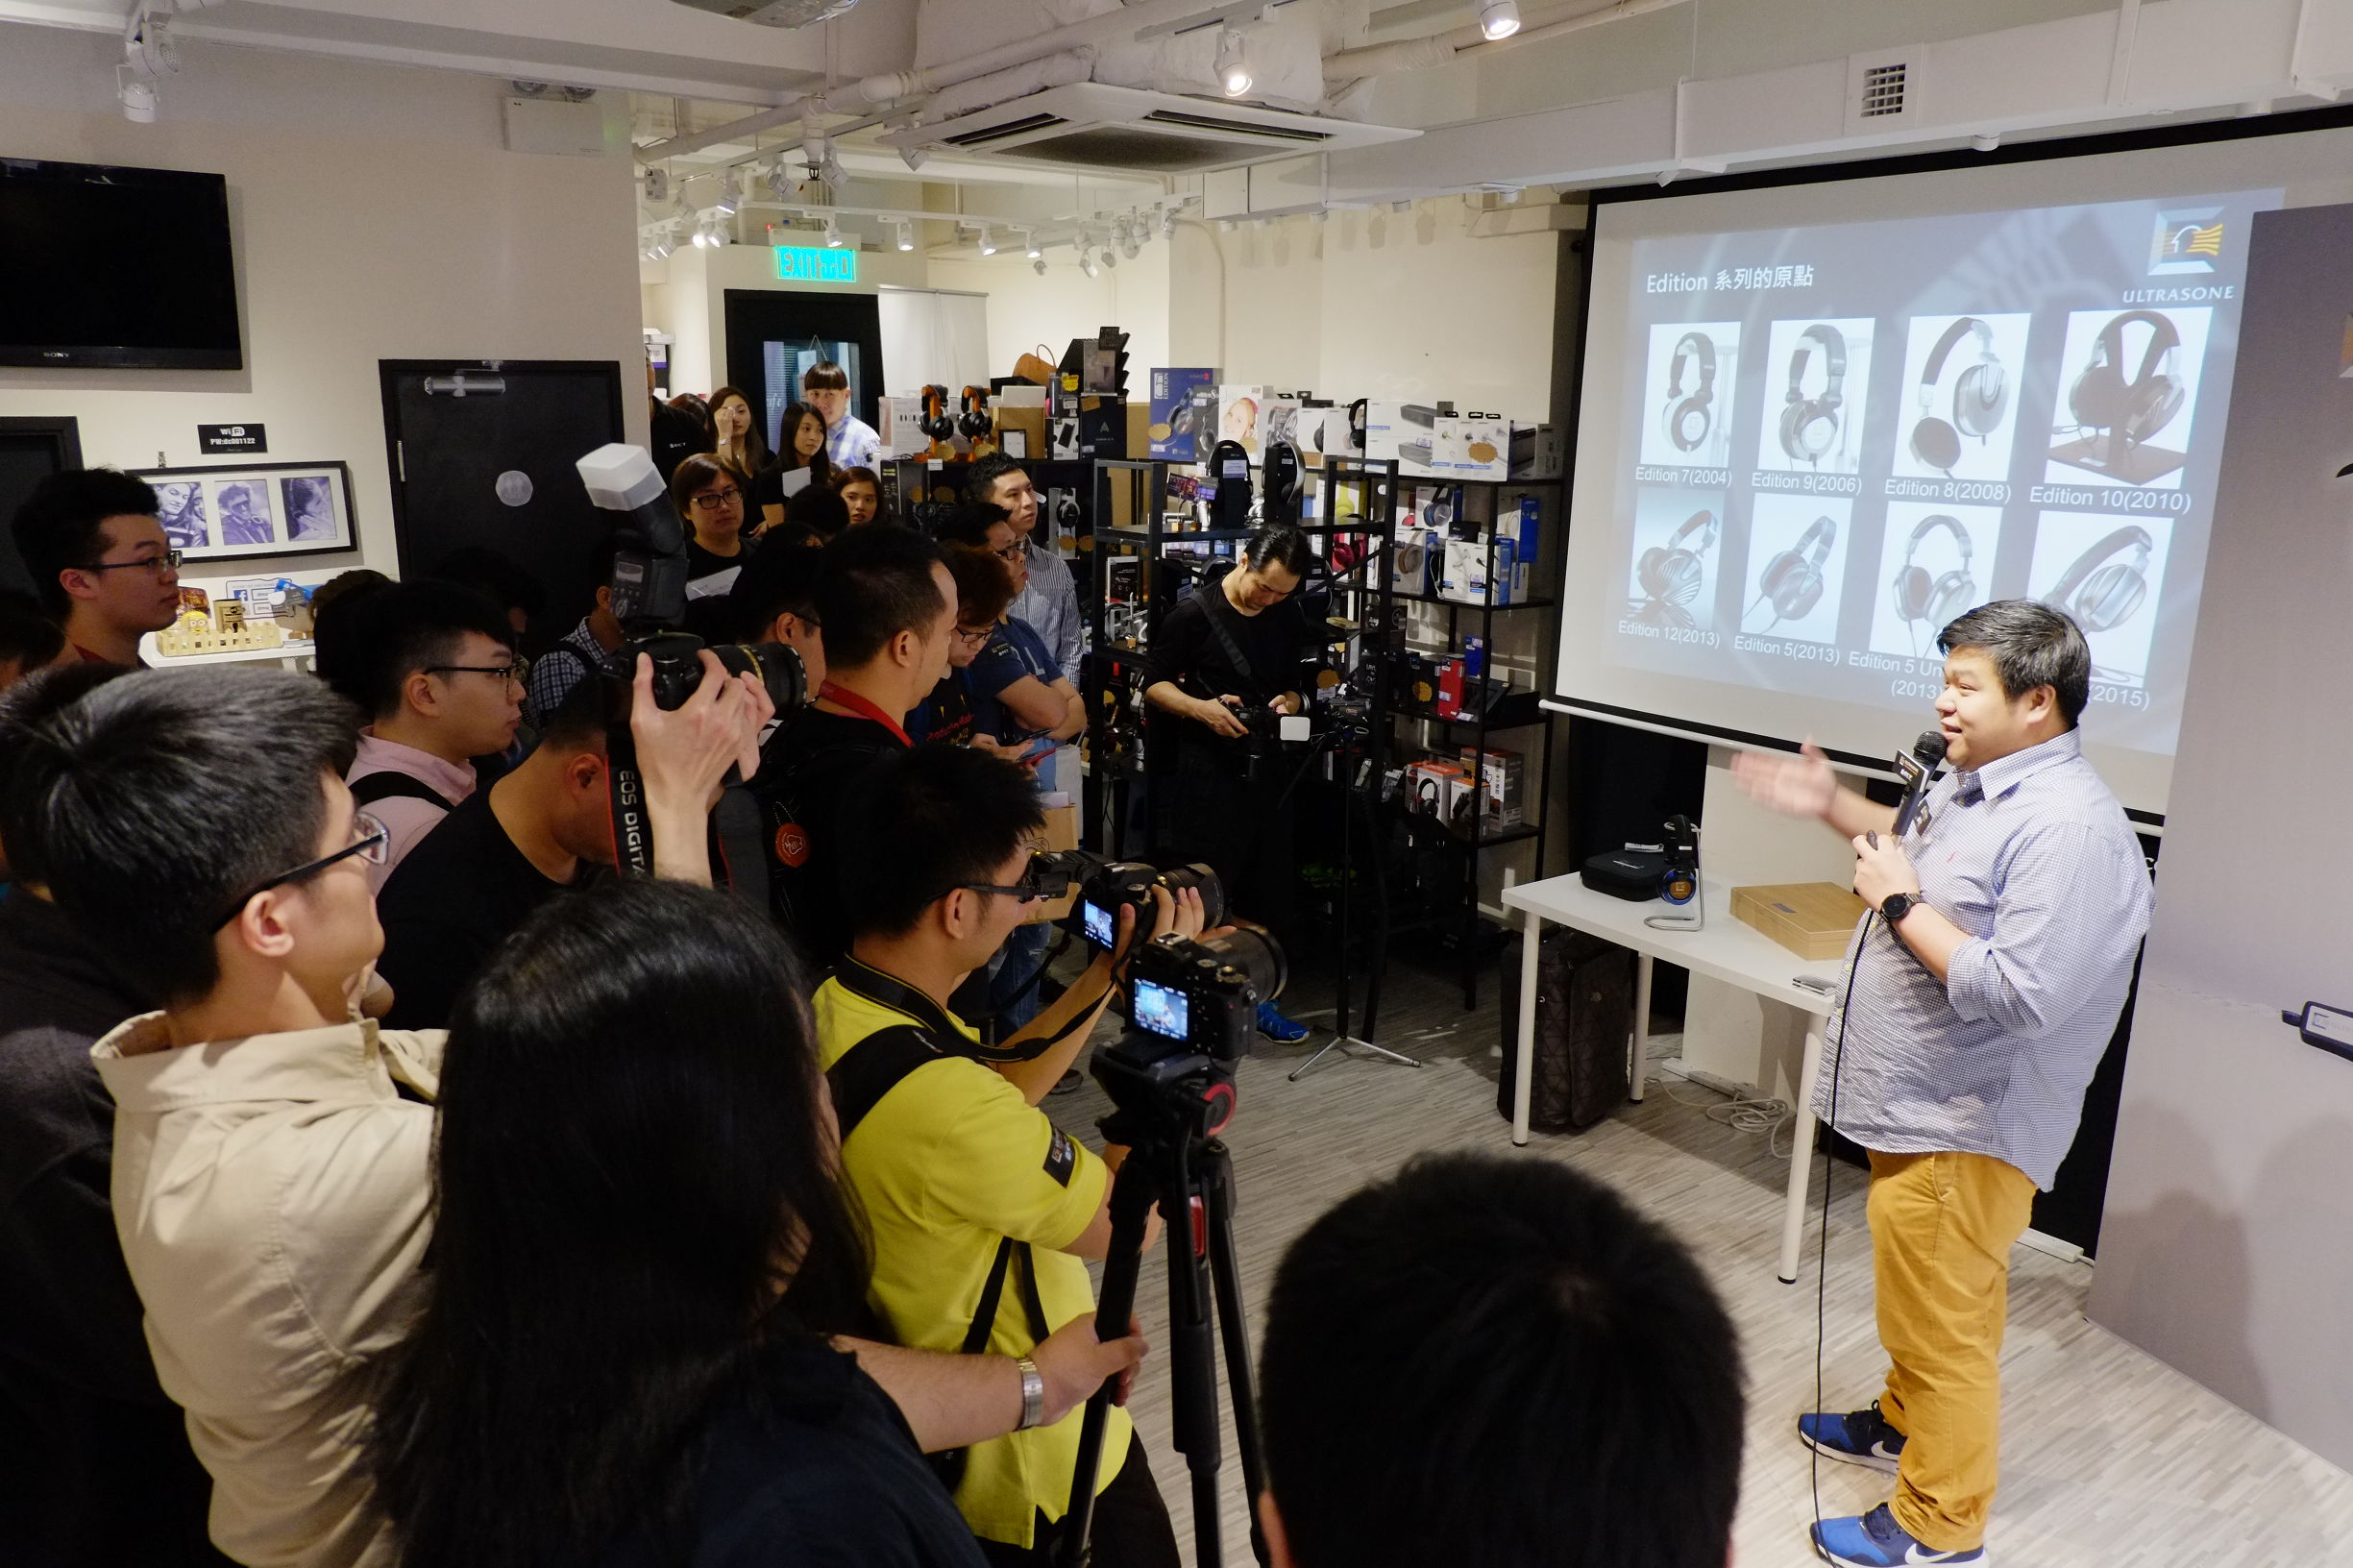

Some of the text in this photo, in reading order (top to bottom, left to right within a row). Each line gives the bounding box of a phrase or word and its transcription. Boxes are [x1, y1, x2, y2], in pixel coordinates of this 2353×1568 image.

[781, 248, 817, 277] EXIT
[1646, 263, 1815, 293] Edition 系列的原點
[2122, 285, 2235, 303] ULTRASONE
[1635, 466, 1732, 488] Edition 7(2004)
[1752, 472, 1862, 496] Edition 9(2006)
[1884, 479, 2012, 504] Edition 8(2008)
[2029, 486, 2193, 515] Edition 10(2010)
[1618, 620, 1721, 649] Edition 12(2013)
[1733, 635, 1840, 667] Edition 5(2013)
[1849, 651, 1900, 672] Edition
[1904, 659, 1915, 674] 5
[619, 770, 639, 806] EOS
